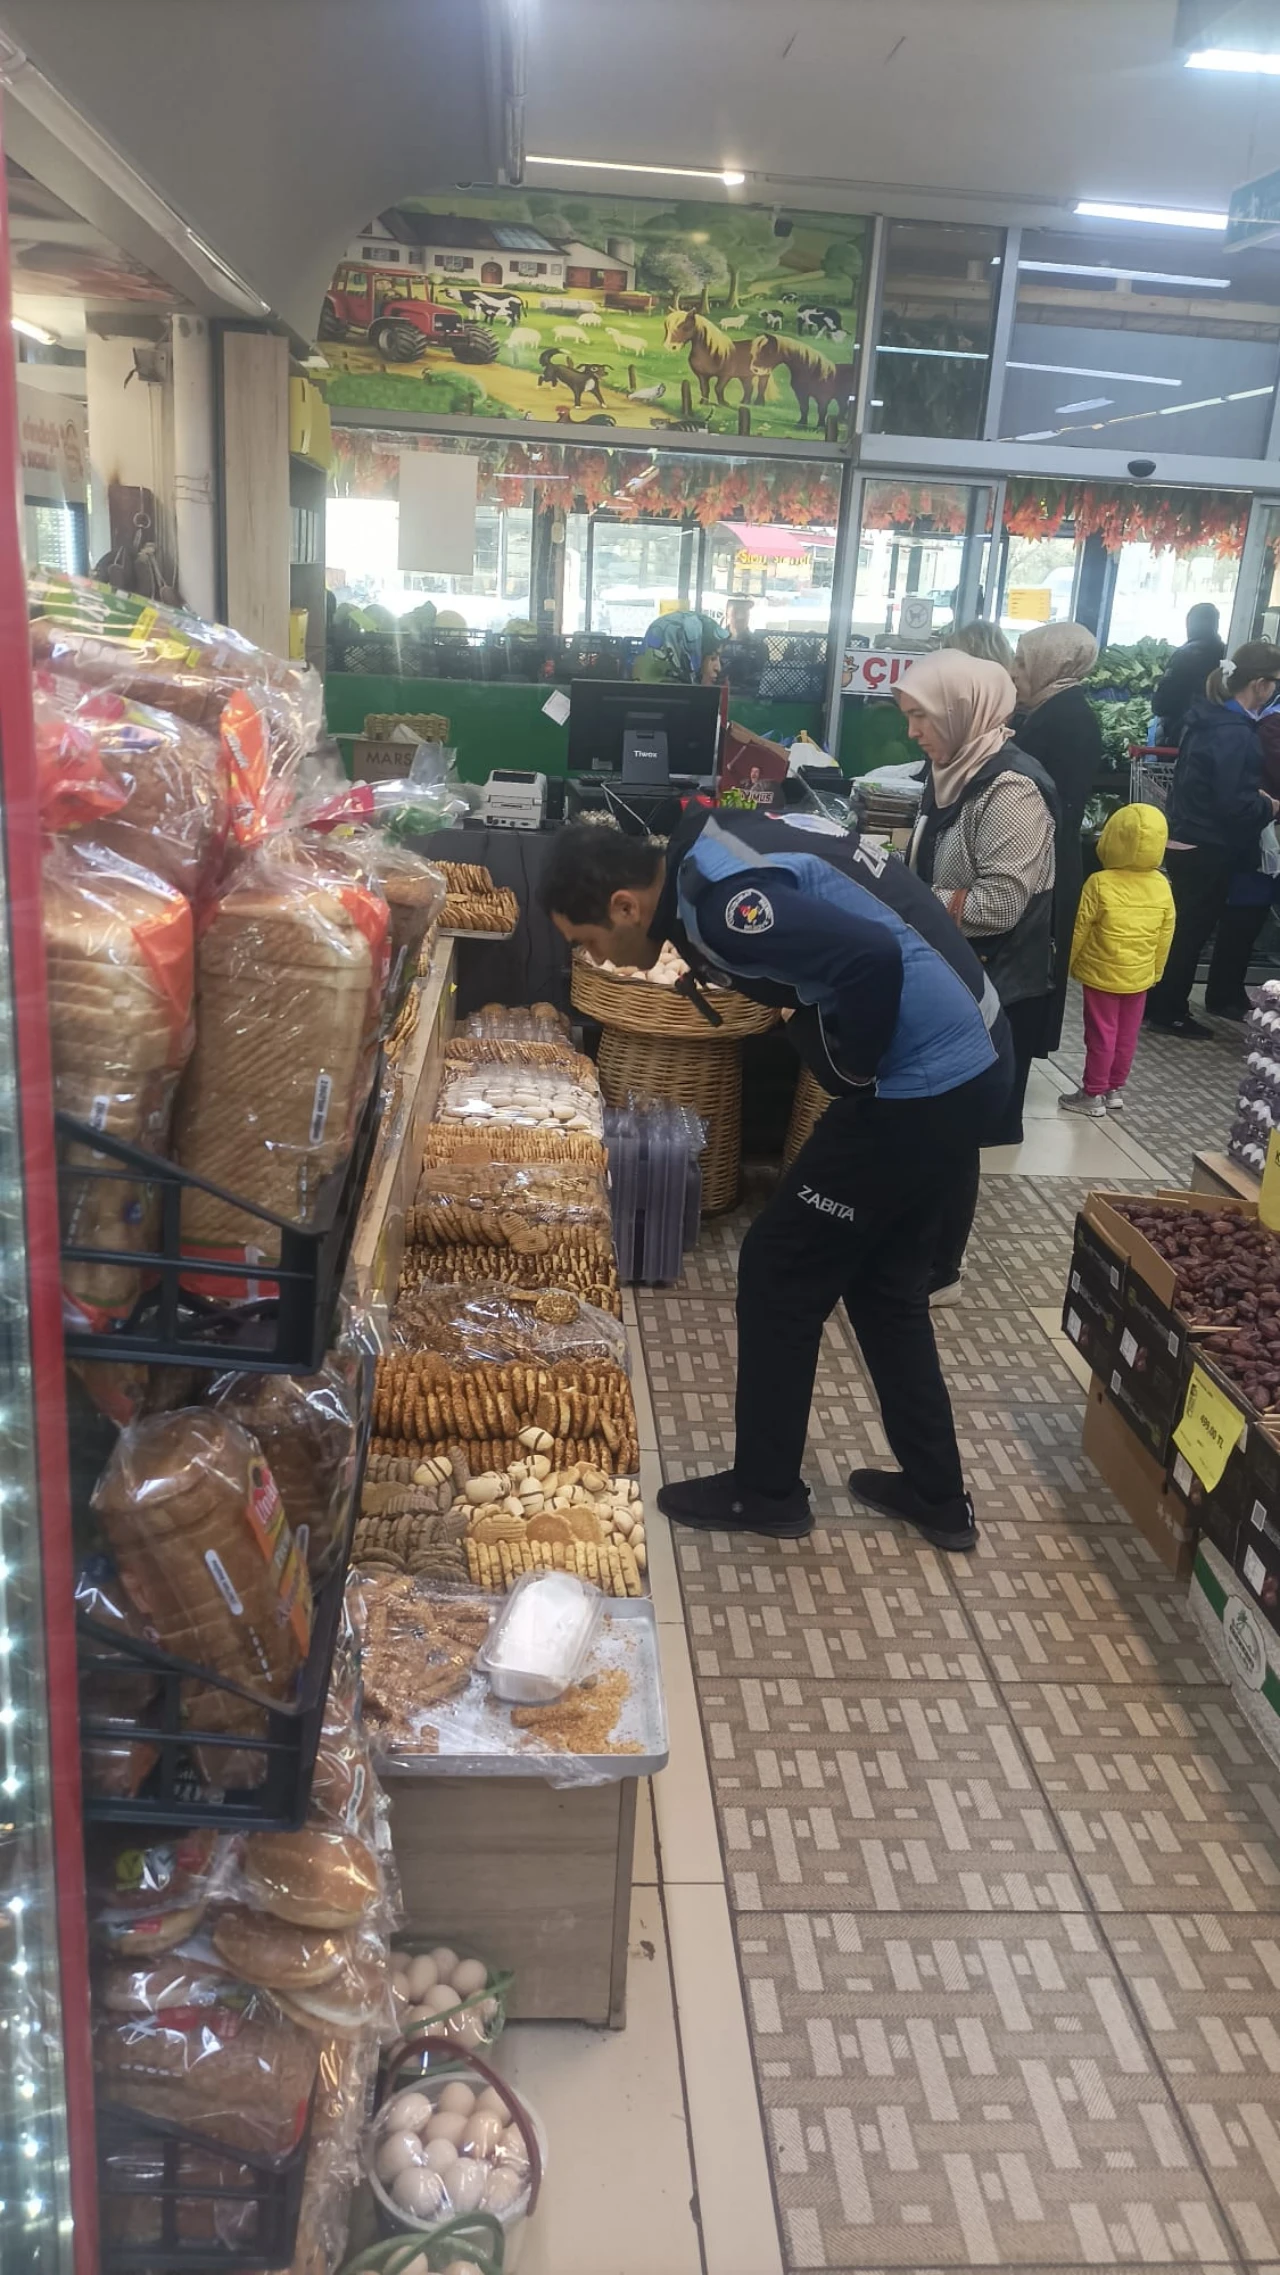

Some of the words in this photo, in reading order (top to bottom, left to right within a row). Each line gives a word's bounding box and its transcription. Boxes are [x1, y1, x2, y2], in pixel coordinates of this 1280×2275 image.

[632, 749, 658, 759] Tiwox
[796, 1184, 855, 1222] ZABITA
[1216, 1433, 1225, 1450] TL
